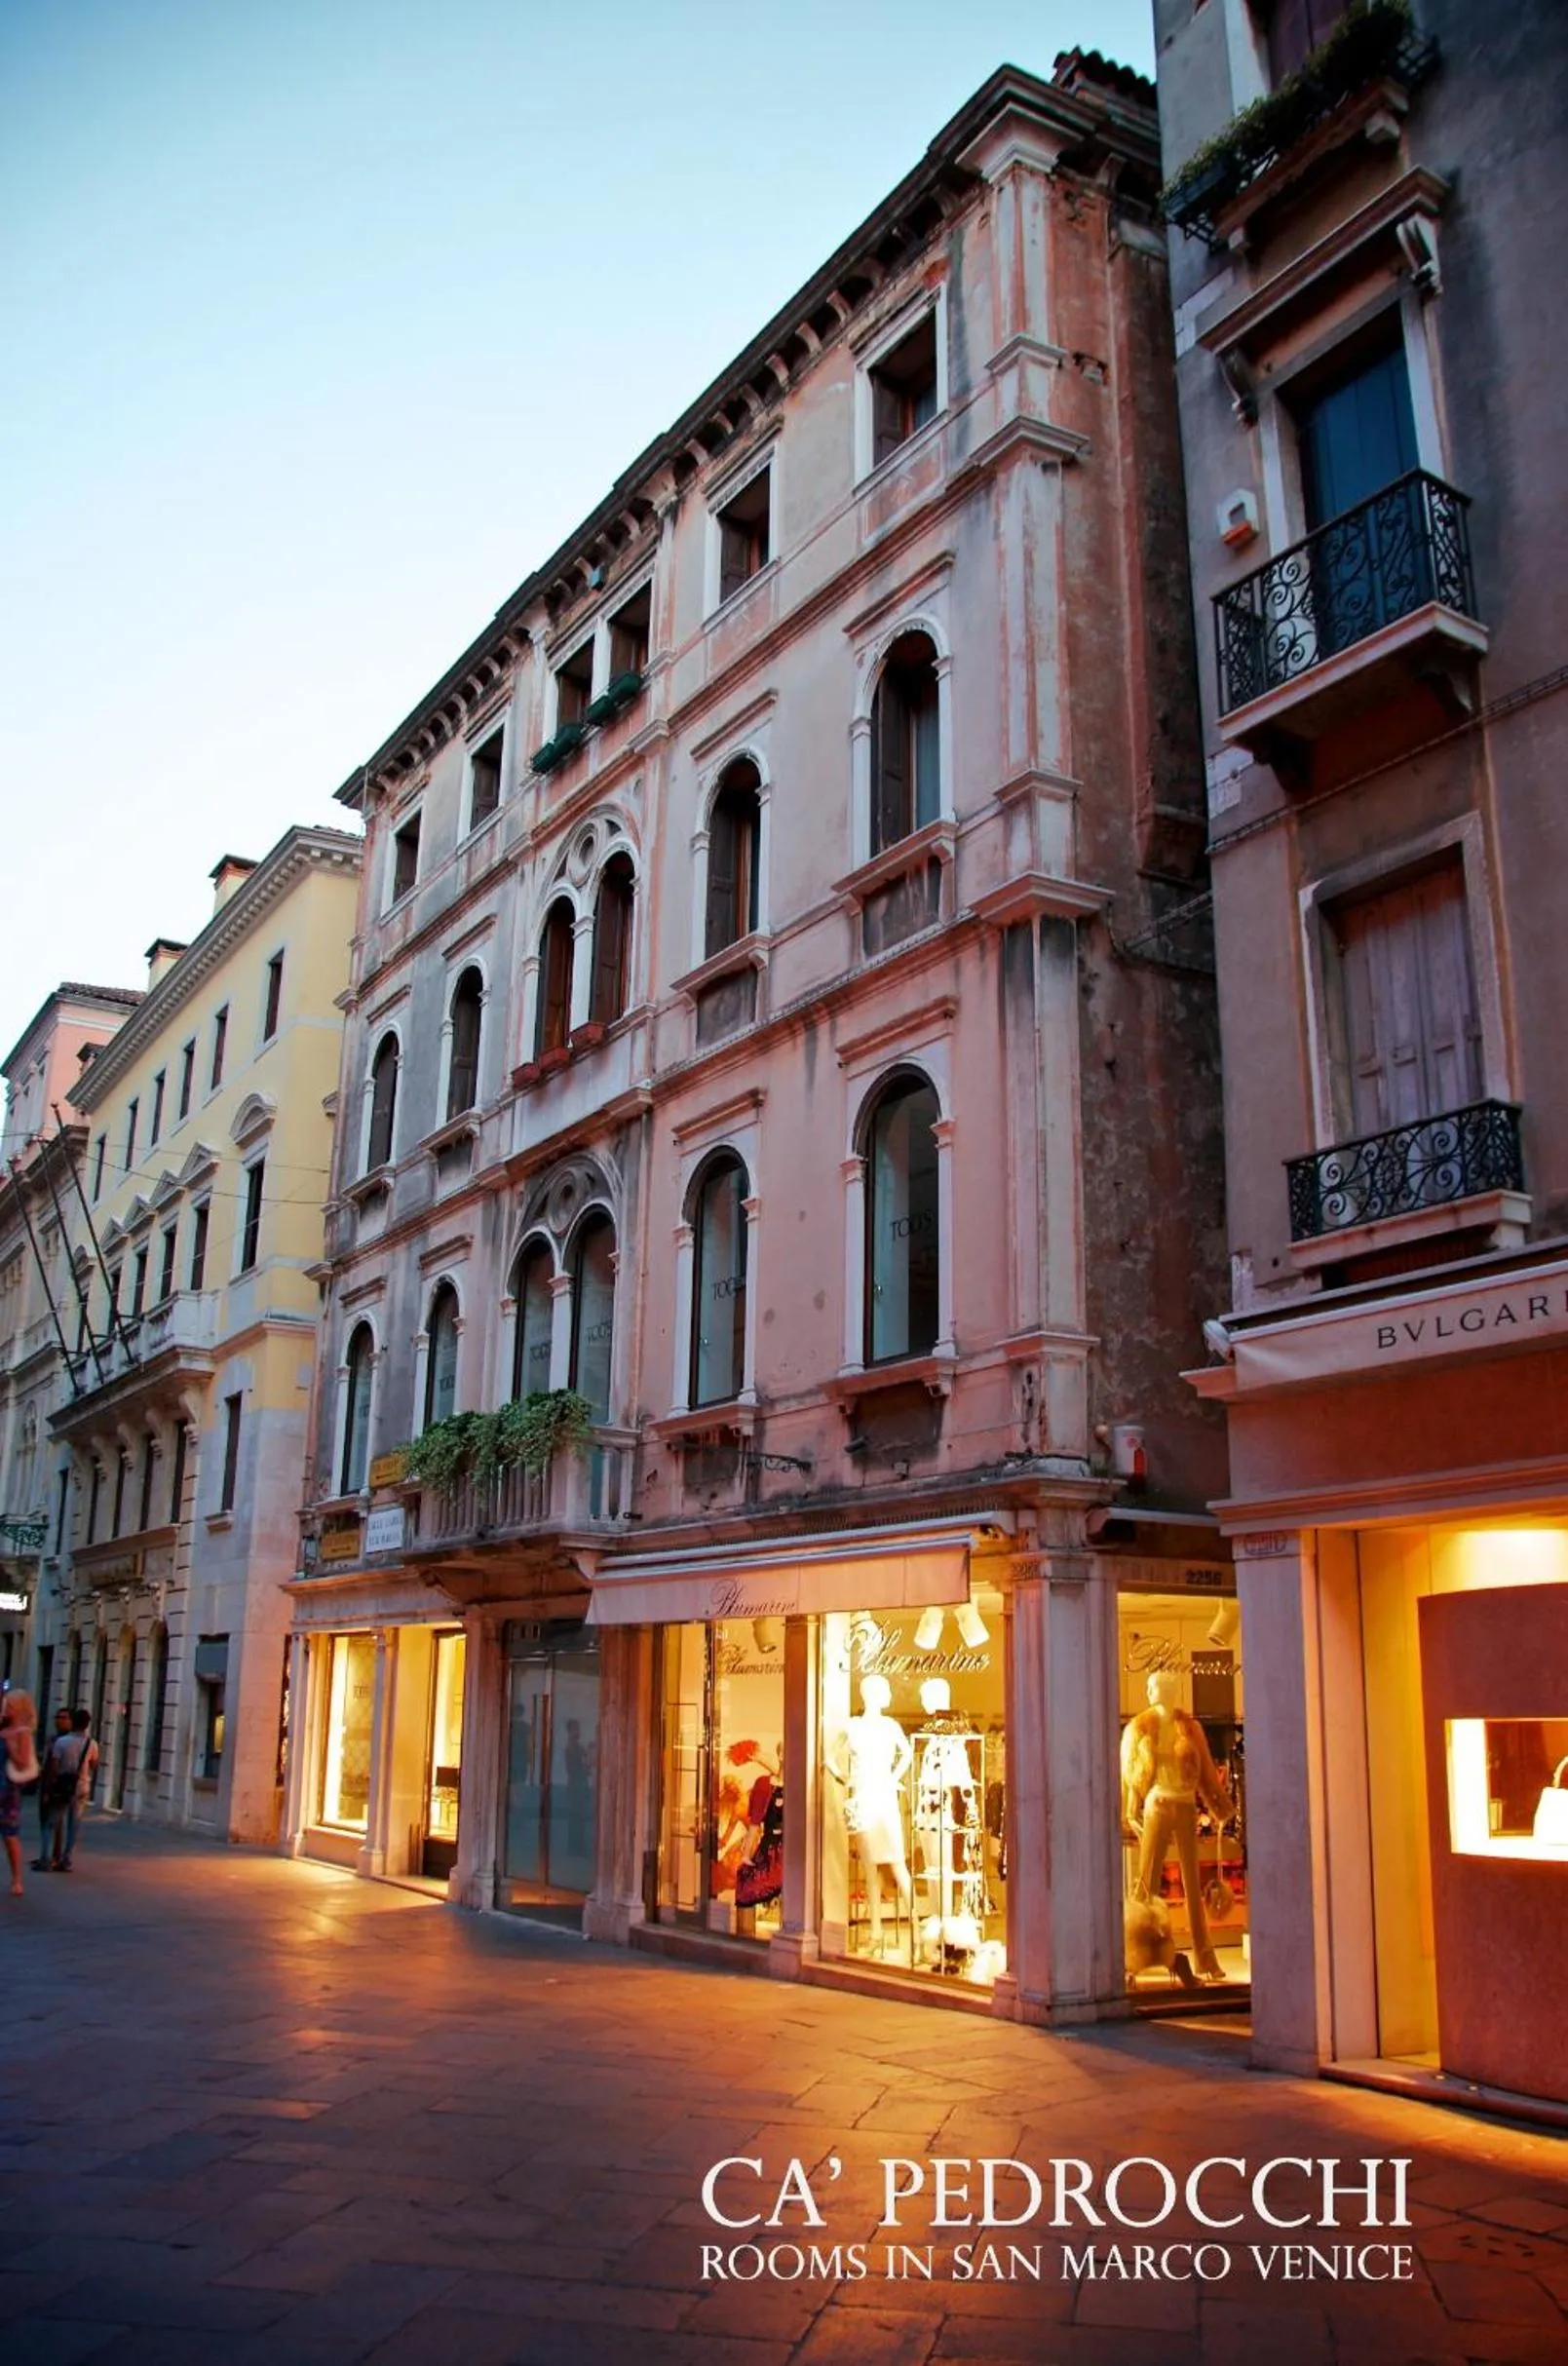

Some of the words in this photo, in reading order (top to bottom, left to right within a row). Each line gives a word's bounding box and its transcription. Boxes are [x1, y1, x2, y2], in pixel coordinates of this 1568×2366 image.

[1377, 1289, 1568, 1350] BVLGARI
[717, 1643, 784, 1675] Blumarin
[839, 1618, 991, 1674] Blumarine
[1124, 1633, 1243, 1675] Blumarin
